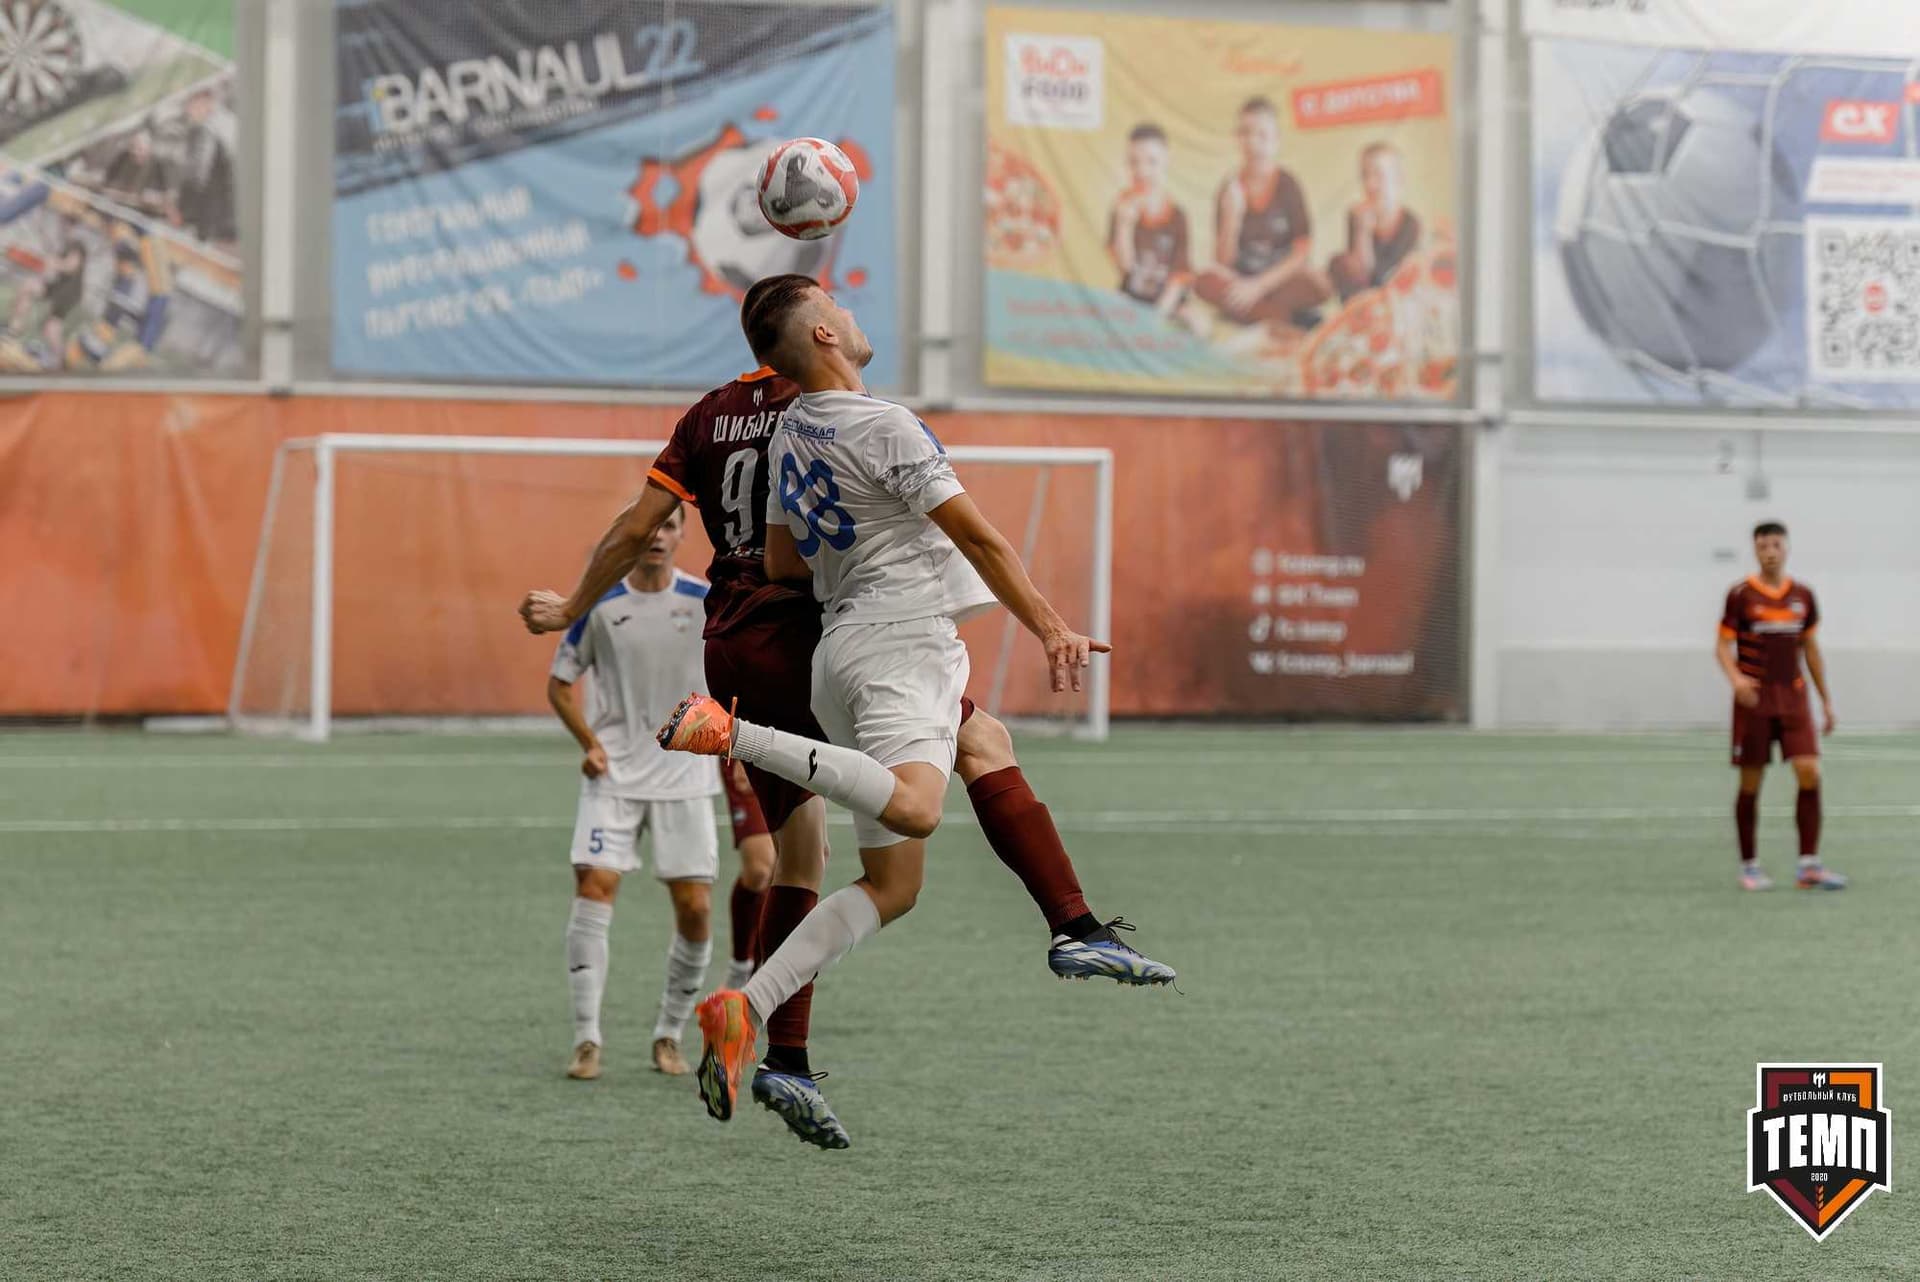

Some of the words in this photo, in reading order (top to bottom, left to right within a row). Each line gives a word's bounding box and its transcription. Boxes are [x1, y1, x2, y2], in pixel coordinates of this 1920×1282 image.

[721, 447, 759, 549] 9
[779, 451, 857, 558] 88
[588, 827, 603, 854] 5
